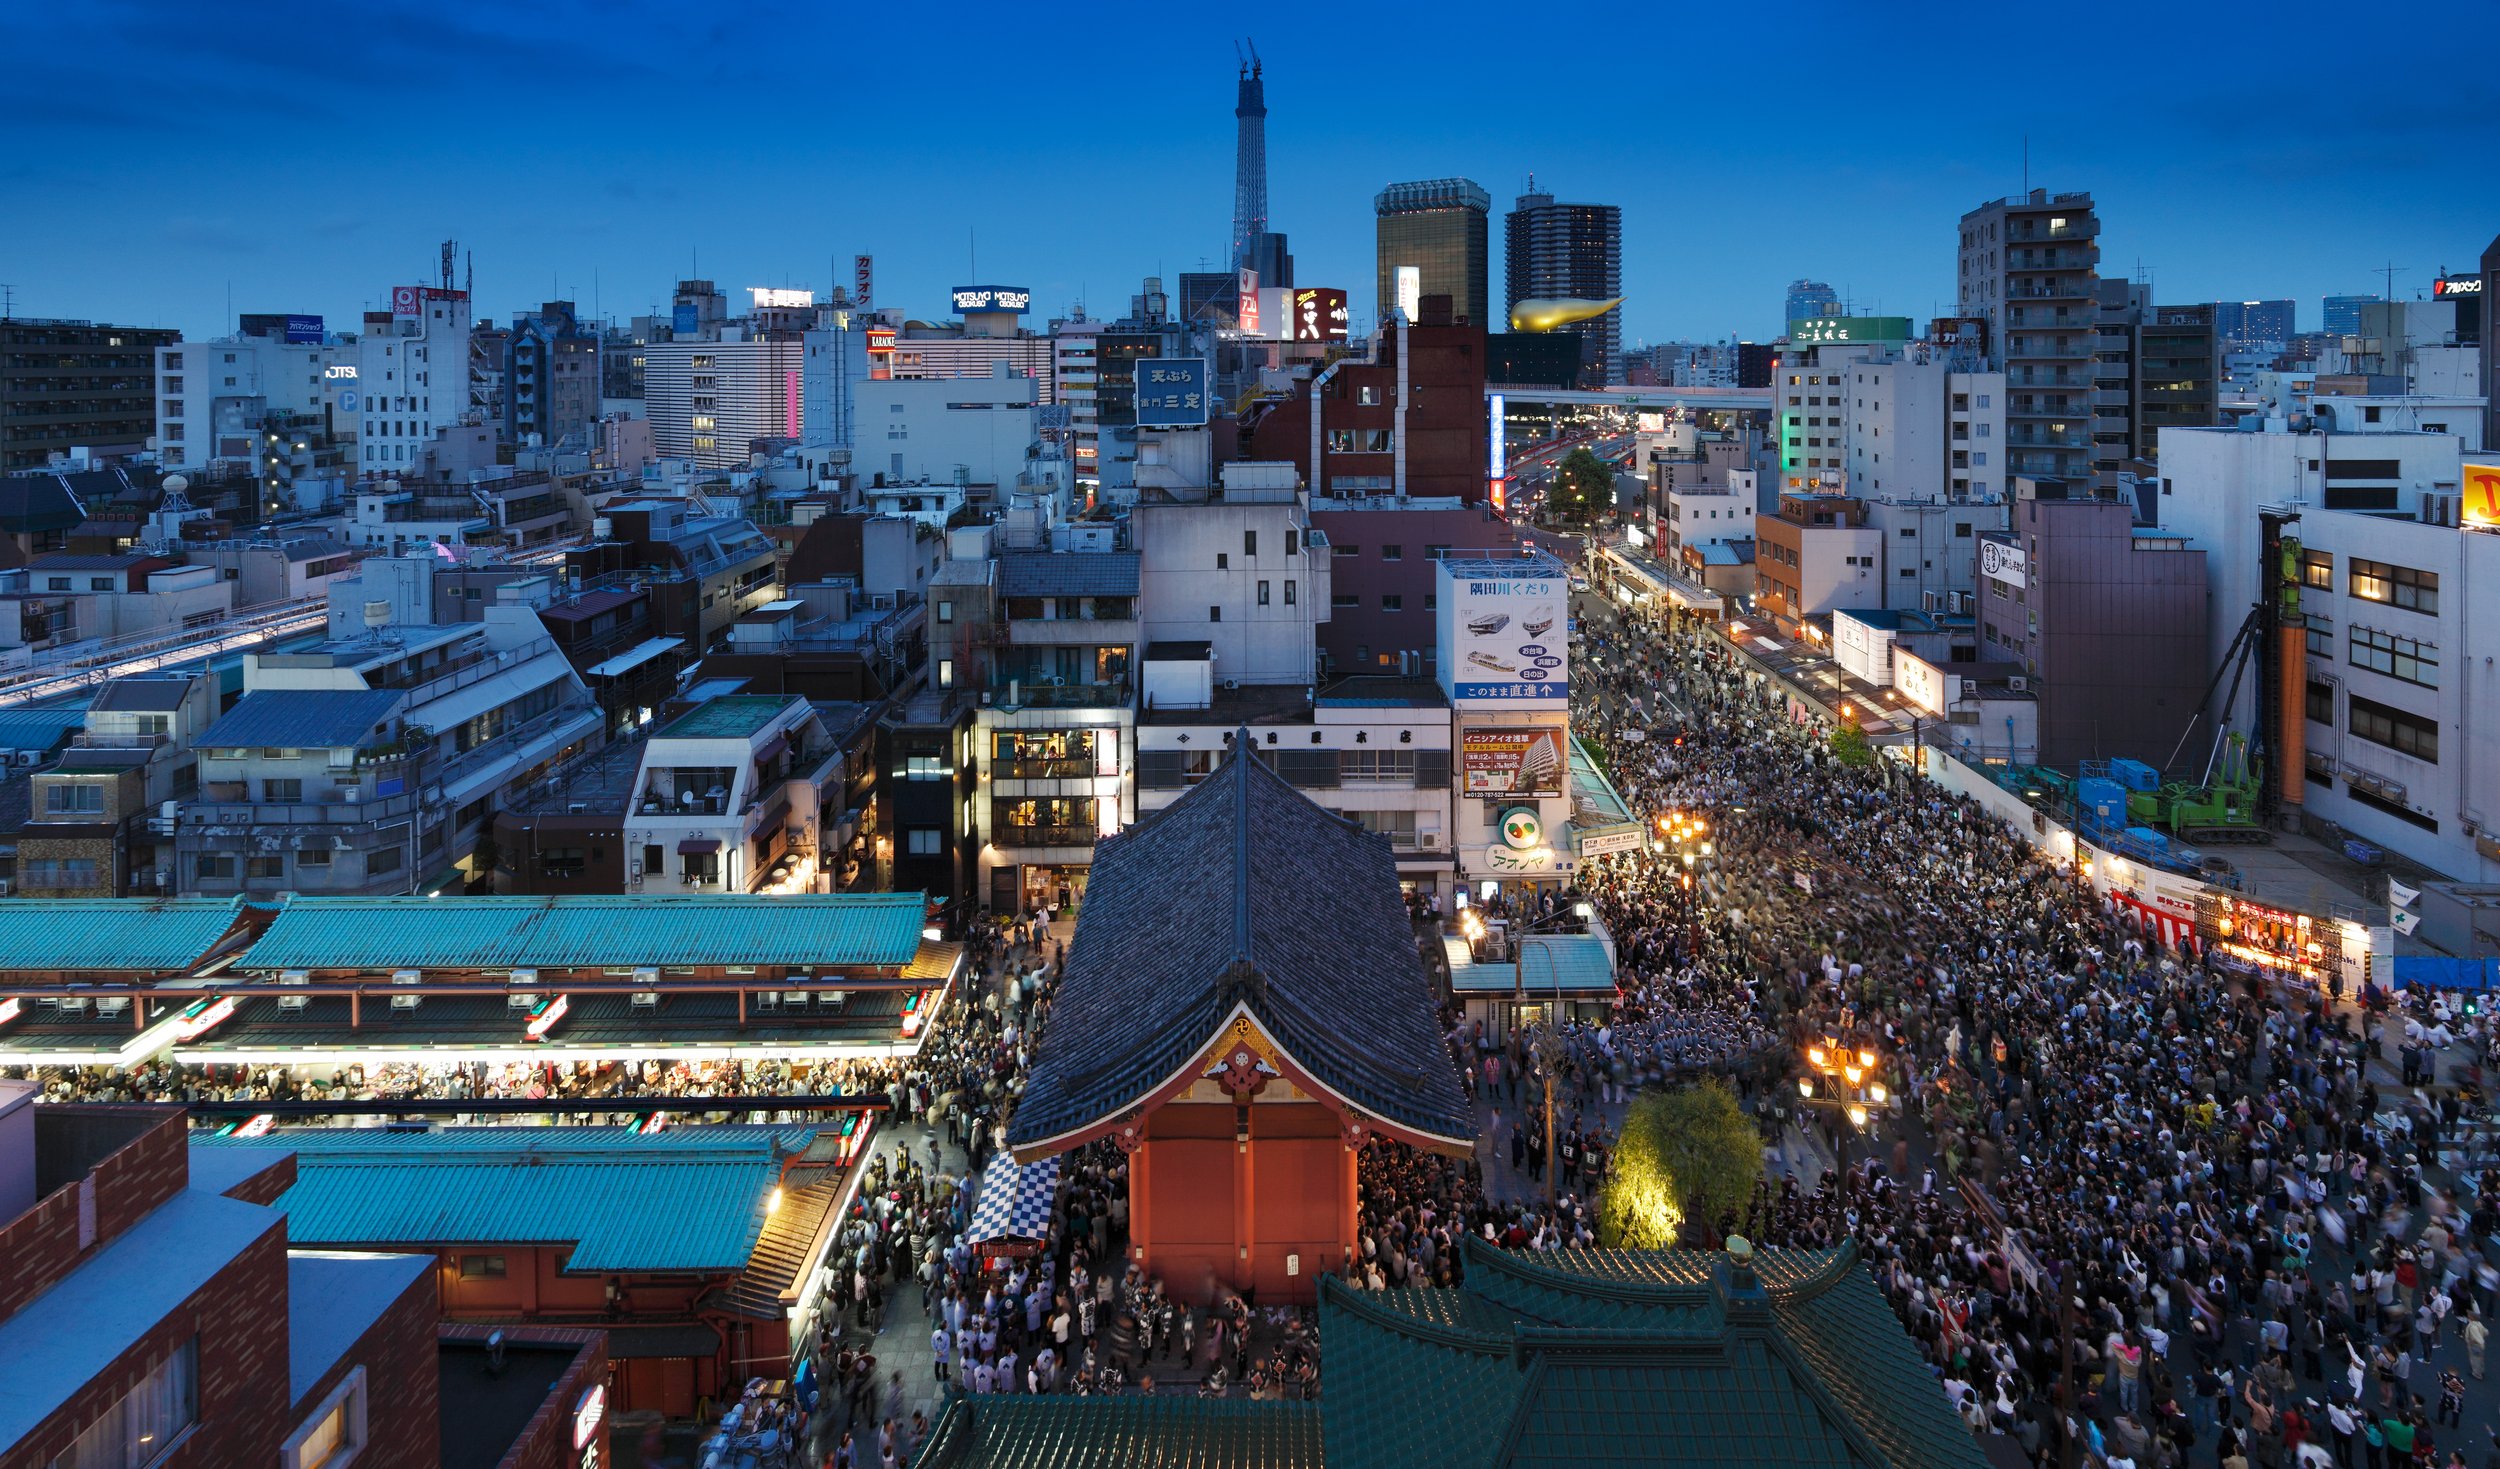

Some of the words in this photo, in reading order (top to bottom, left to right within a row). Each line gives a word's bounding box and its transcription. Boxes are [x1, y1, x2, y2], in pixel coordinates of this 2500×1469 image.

[858, 257, 870, 305] カラオケ
[2445, 280, 2482, 294] アルメック
[1242, 295, 1257, 313] アコム
[872, 336, 896, 347] KARAOKE
[1151, 369, 1192, 383] 天ぷら
[344, 392, 356, 410] P
[1164, 392, 1201, 409] 三定
[1470, 582, 1549, 596] 隅田川くだり
[1467, 684, 1537, 697] このまま直進
[1465, 735, 1529, 743] イニシアイオ浅草
[1492, 855, 1545, 870] アオノヤ
